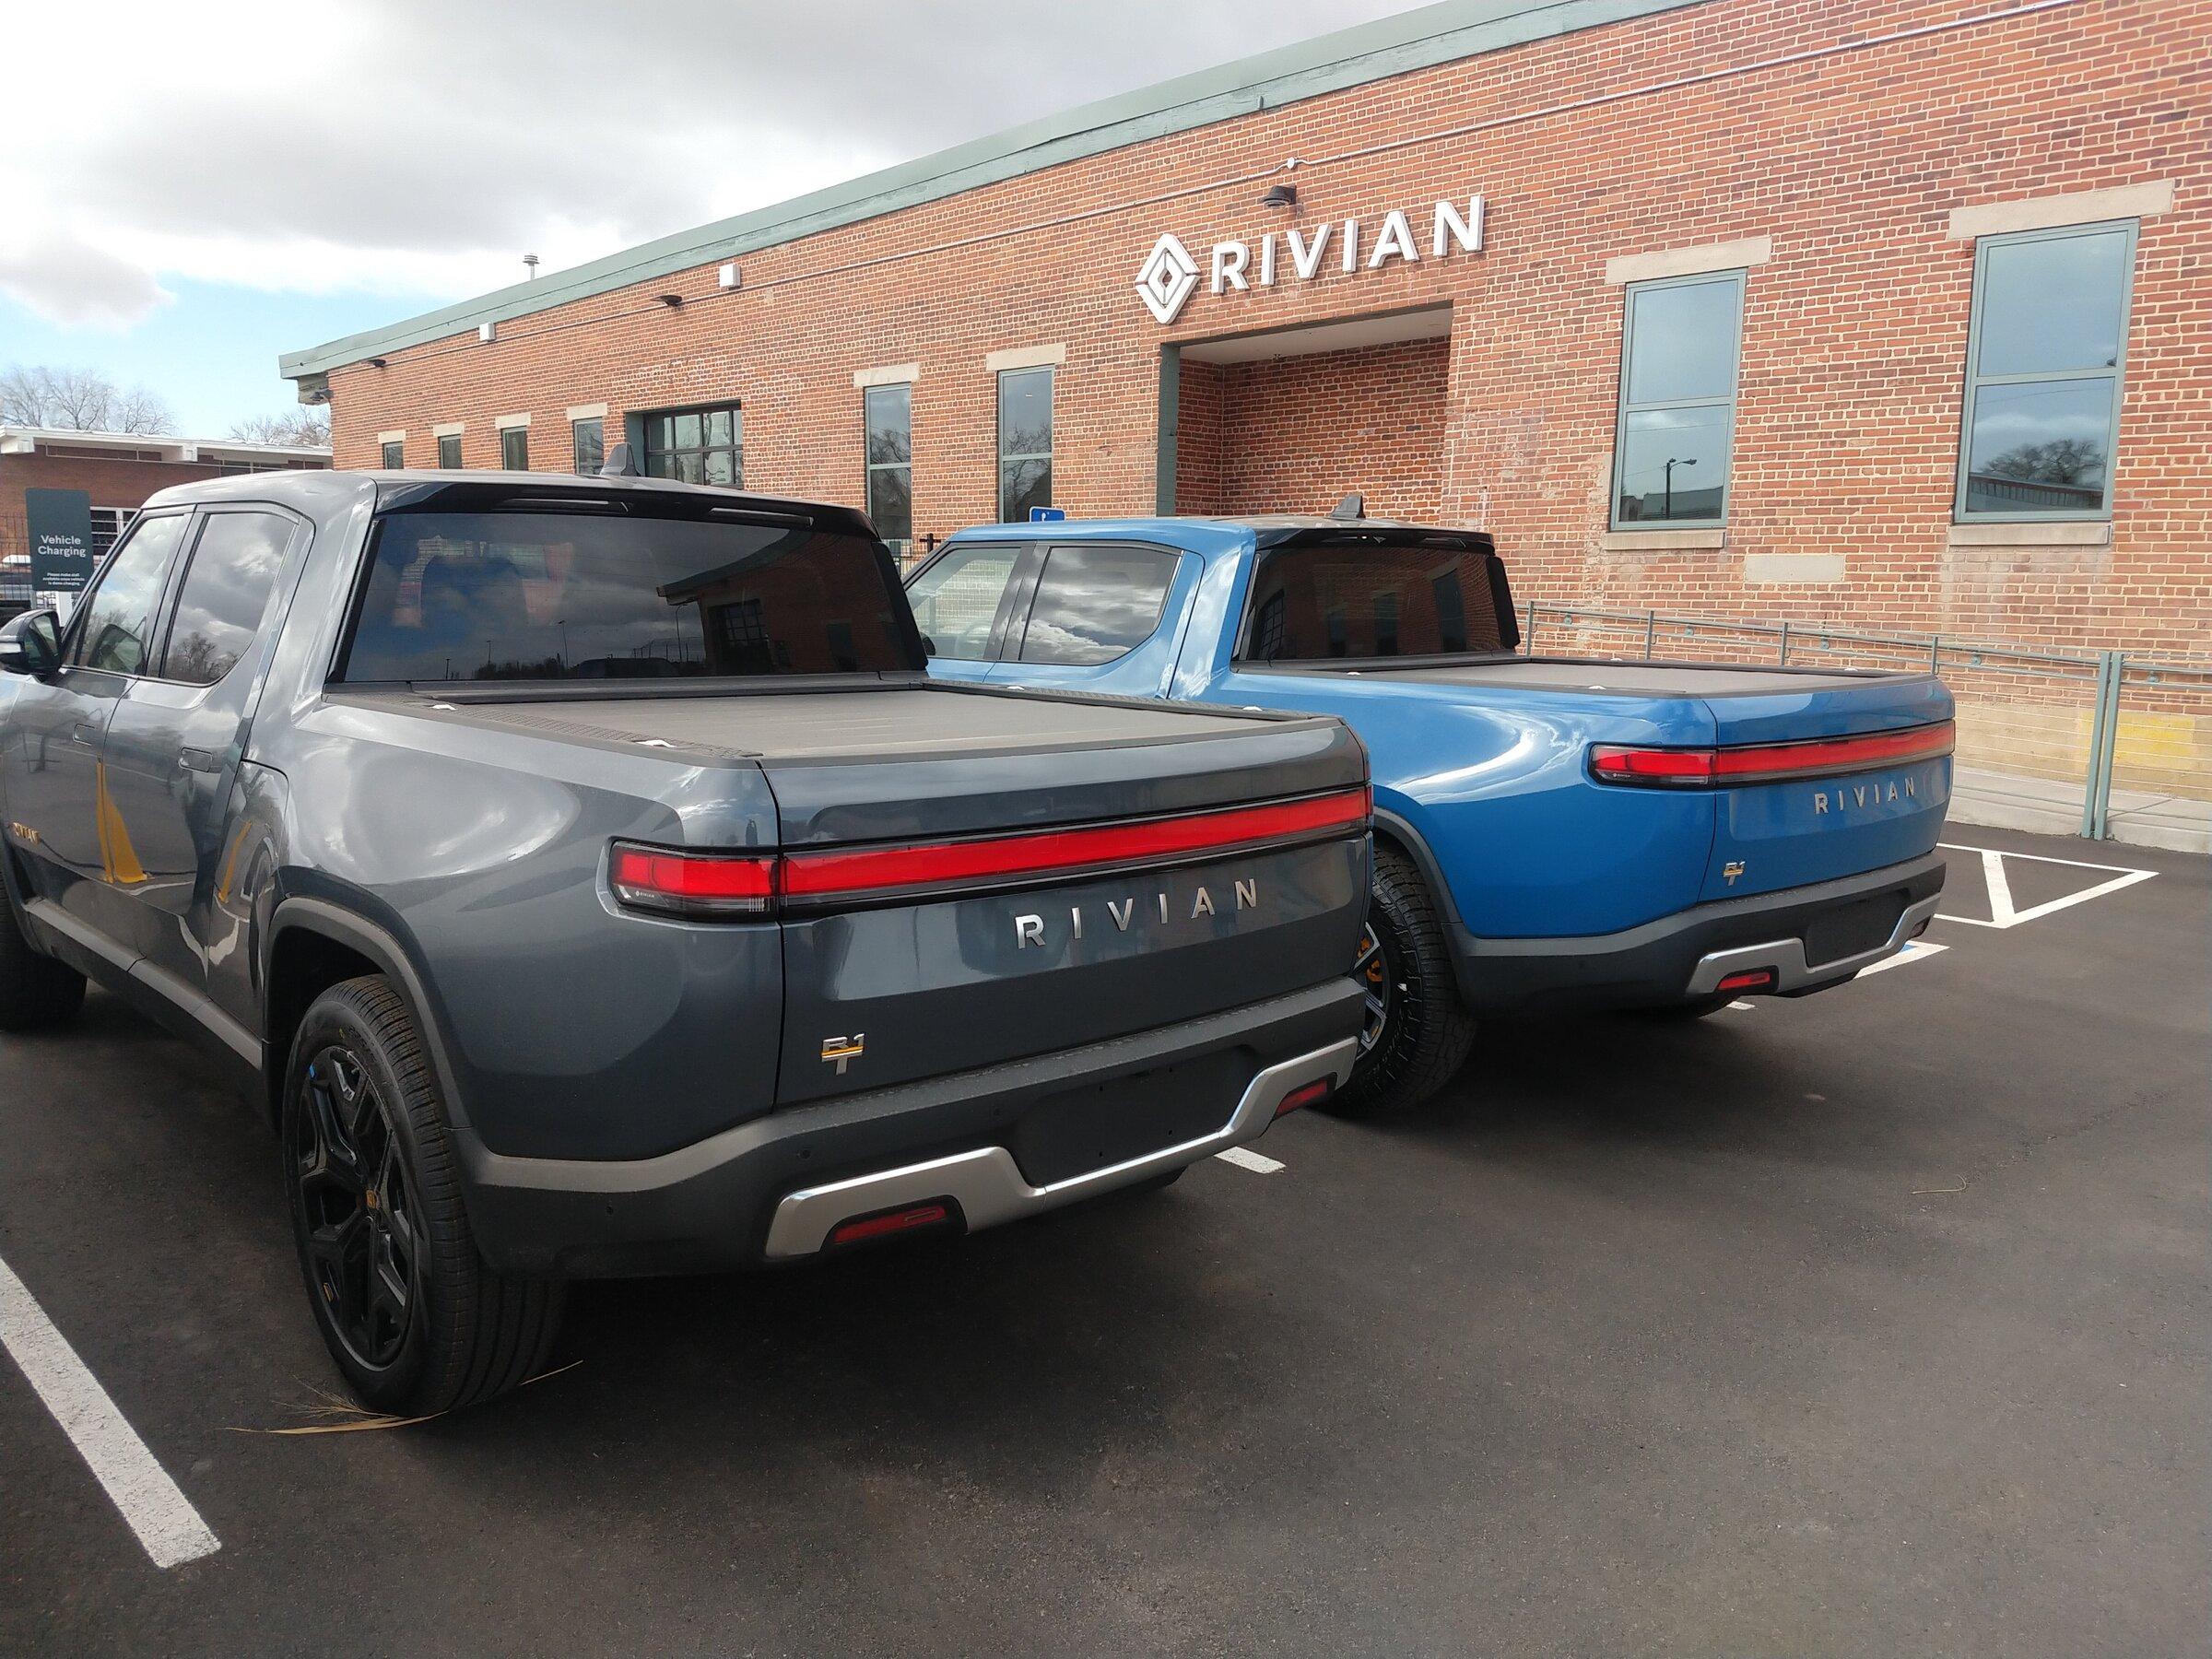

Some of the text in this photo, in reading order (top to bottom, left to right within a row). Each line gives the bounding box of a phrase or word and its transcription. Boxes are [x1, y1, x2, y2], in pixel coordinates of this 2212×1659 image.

[1210, 195, 1486, 294] RIVIAN
[38, 546, 87, 558] Charging
[40, 535, 81, 545] Vehicle
[1814, 777, 1915, 815] RIVIAN
[1015, 878, 1258, 949] RIVIAN
